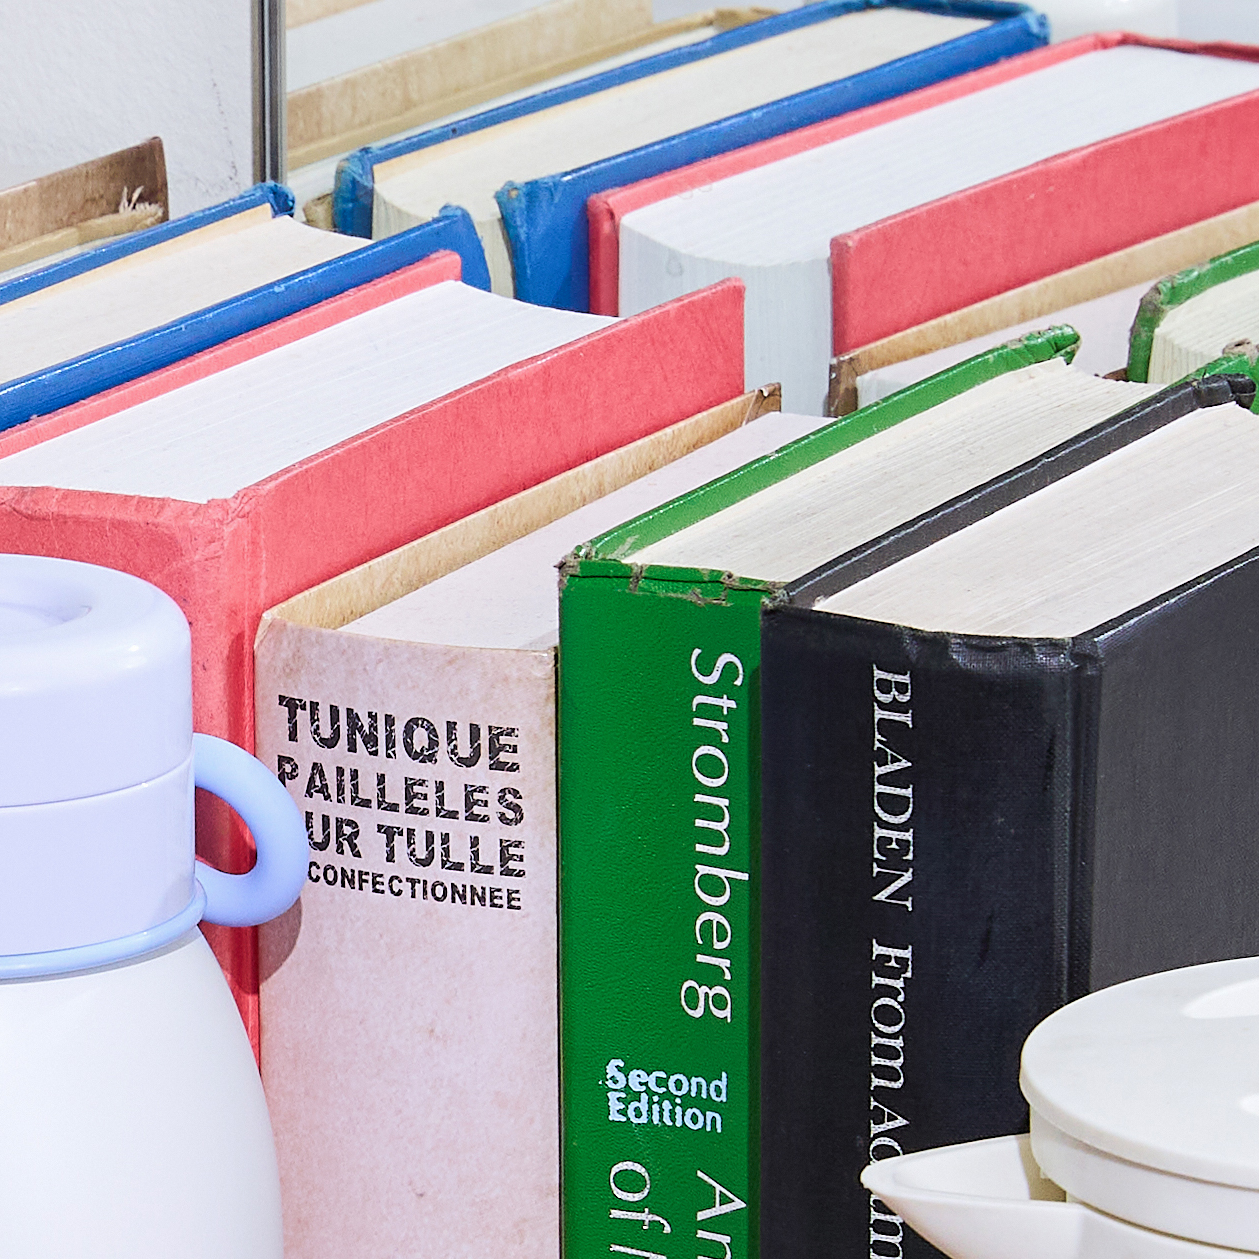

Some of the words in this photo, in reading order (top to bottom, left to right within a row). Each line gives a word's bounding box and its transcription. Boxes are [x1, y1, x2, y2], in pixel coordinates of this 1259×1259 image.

[277, 694, 521, 773] TUNIQUE
[277, 754, 525, 827] PAILLELES
[871, 662, 915, 912] BLADEN
[304, 810, 362, 859] UR
[376, 823, 526, 878] TULLE
[679, 647, 750, 1024] Stromberg
[307, 861, 523, 911] CONFECTIONNEE
[869, 937, 914, 1091] From
[604, 1057, 729, 1103] Second
[606, 1091, 723, 1134] Edition
[608, 1160, 672, 1235] of
